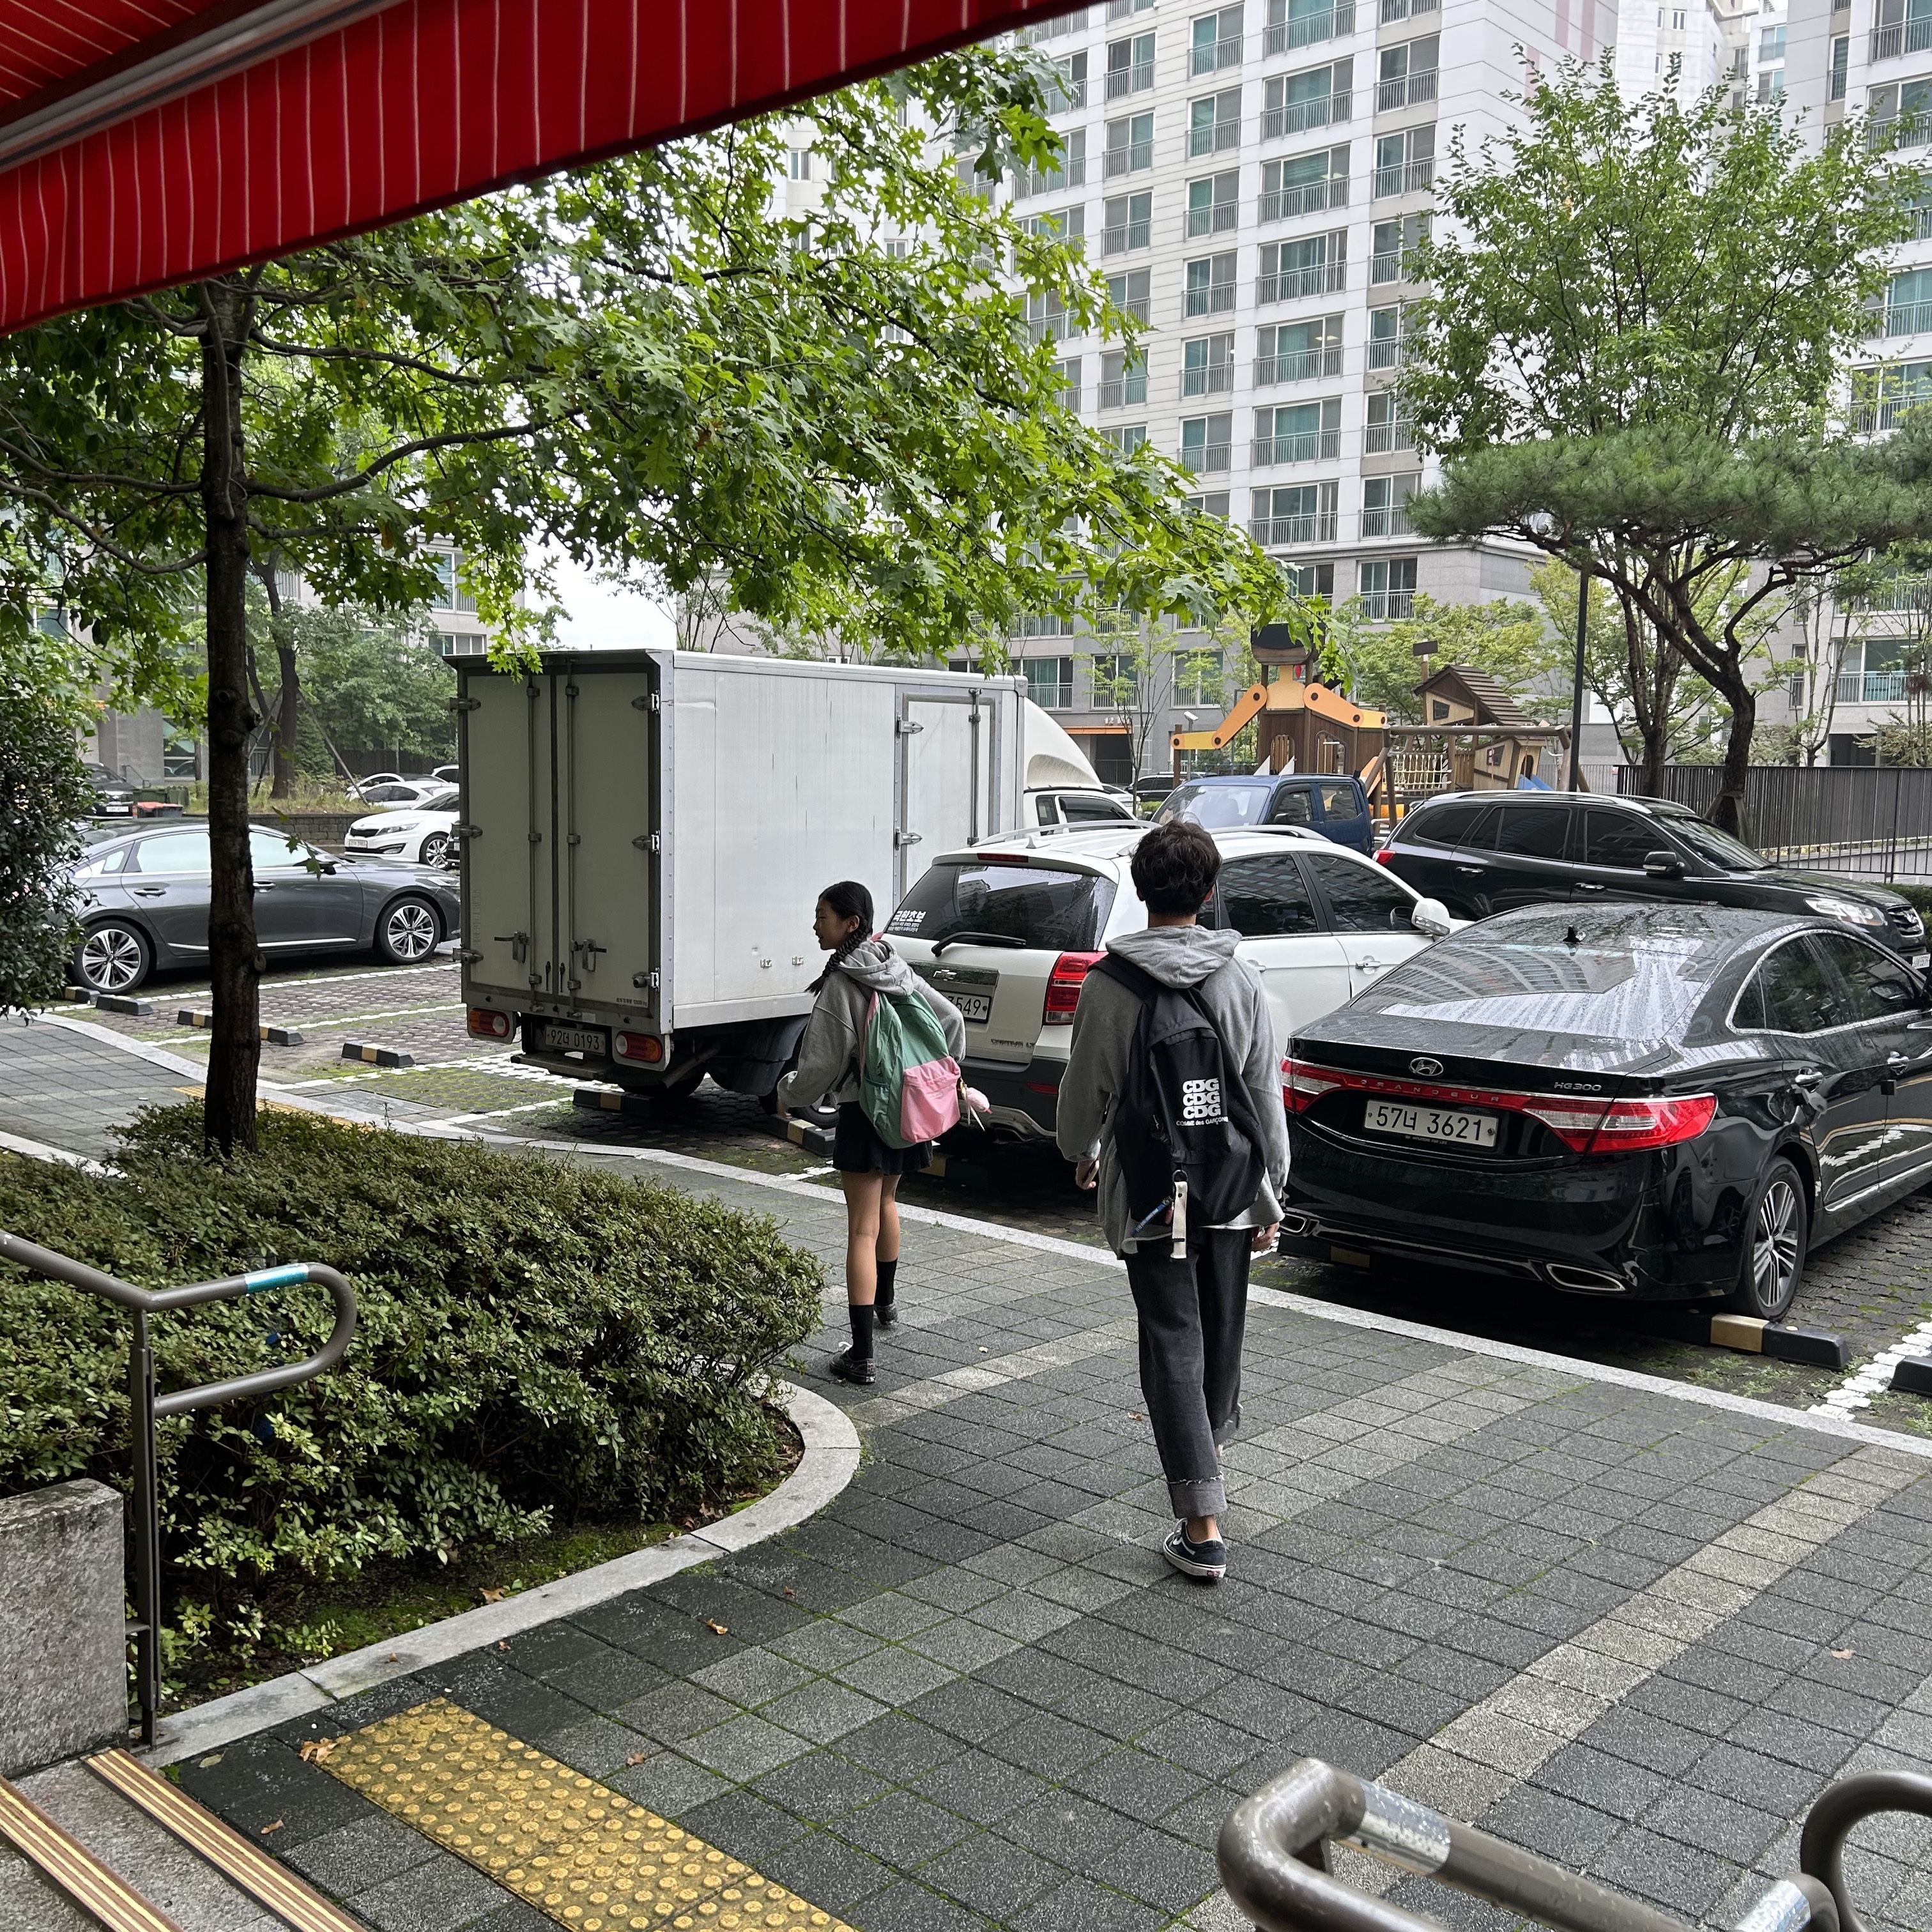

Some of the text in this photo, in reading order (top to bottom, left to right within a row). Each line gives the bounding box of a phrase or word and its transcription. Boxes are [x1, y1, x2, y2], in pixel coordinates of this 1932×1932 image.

[893, 910, 926, 923] 극한초보
[551, 1029, 599, 1050] 92더 0193
[1183, 1078, 1220, 1094] CDG
[1360, 1078, 1499, 1102] GRANDEUR
[1554, 1082, 1602, 1091] HG300
[1183, 1091, 1220, 1107] CDG
[1183, 1103, 1222, 1119] CDG
[1376, 1106, 1482, 1141] 57너 3621
